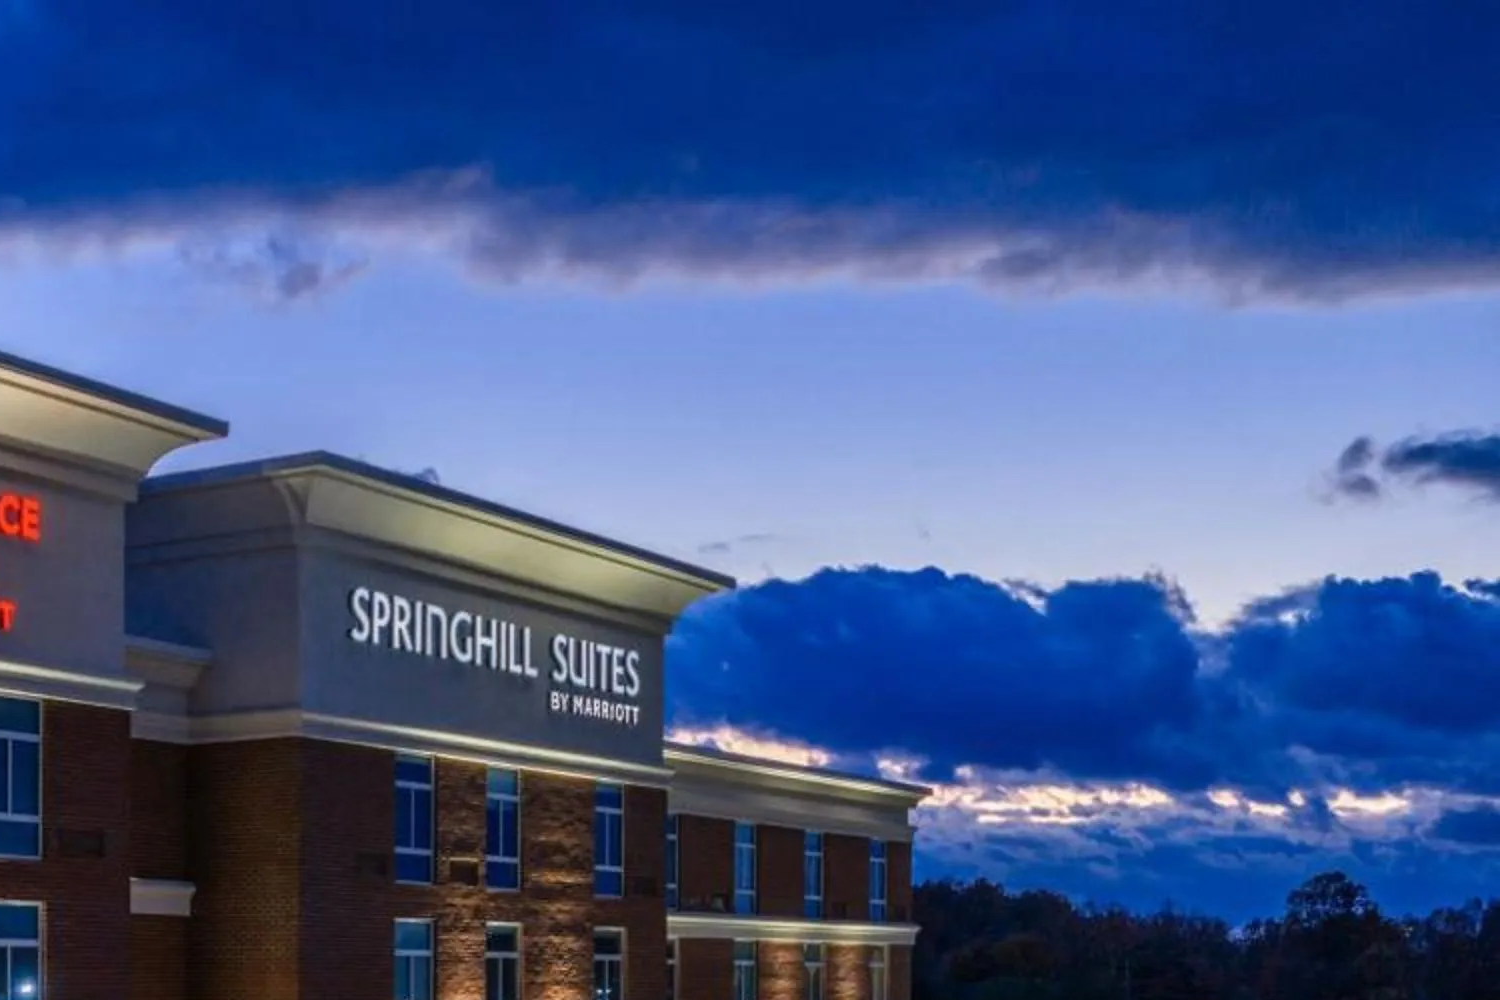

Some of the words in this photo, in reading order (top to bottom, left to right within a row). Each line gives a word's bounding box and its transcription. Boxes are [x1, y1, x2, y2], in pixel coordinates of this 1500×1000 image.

[350, 586, 539, 678] SPRINGHILL
[552, 633, 641, 697] SUITES
[550, 691, 570, 712] BY
[572, 695, 641, 725] MARRIOTT
